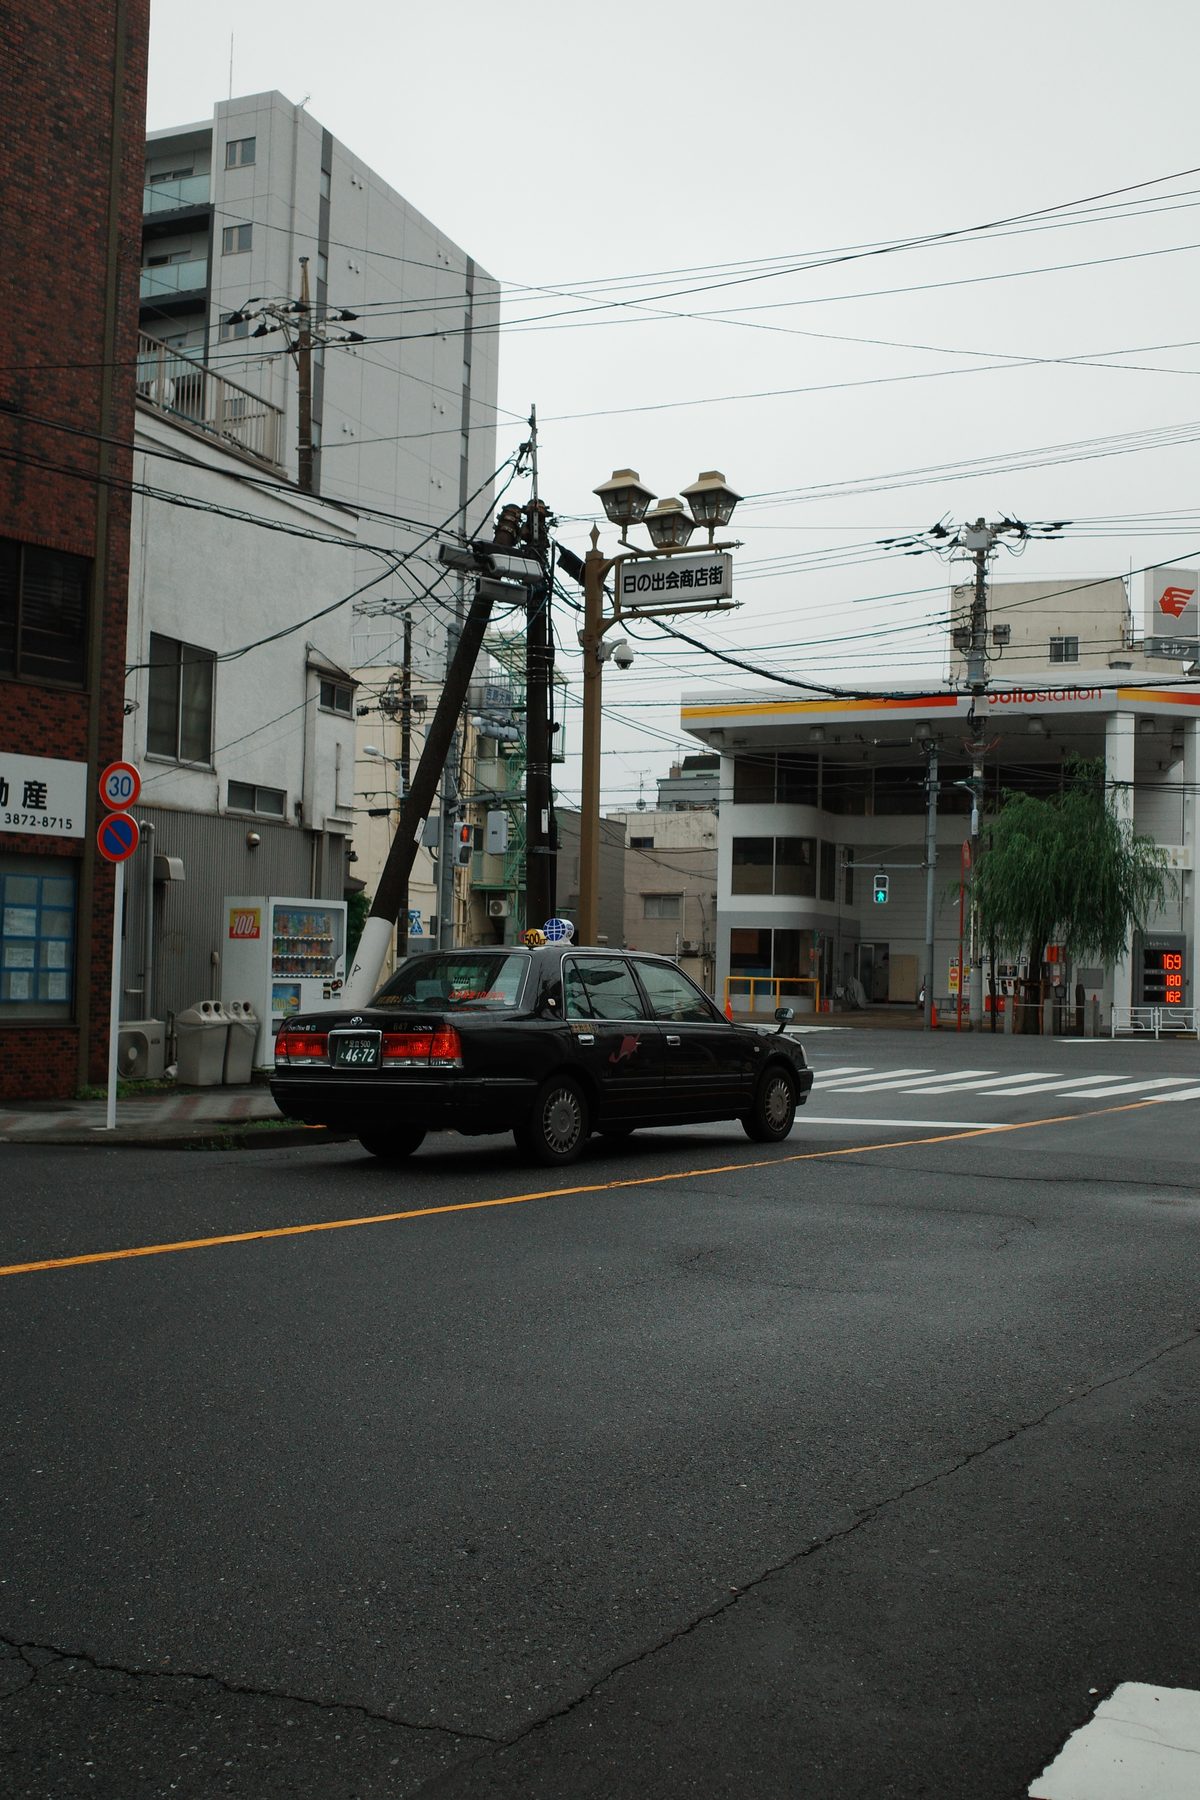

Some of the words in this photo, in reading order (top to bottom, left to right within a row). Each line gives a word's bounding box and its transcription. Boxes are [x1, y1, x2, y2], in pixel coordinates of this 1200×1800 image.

[623, 565, 724, 594] 日の出会商店街
[1160, 642, 1191, 656] セルフ
[108, 775, 132, 797] 30
[4, 812, 72, 830] 3872-8715
[1163, 954, 1181, 970] 169
[1166, 974, 1181, 986] 180
[1166, 991, 1181, 1003] 162
[360, 1040, 371, 1048] 500
[345, 1048, 375, 1062] 46-72
